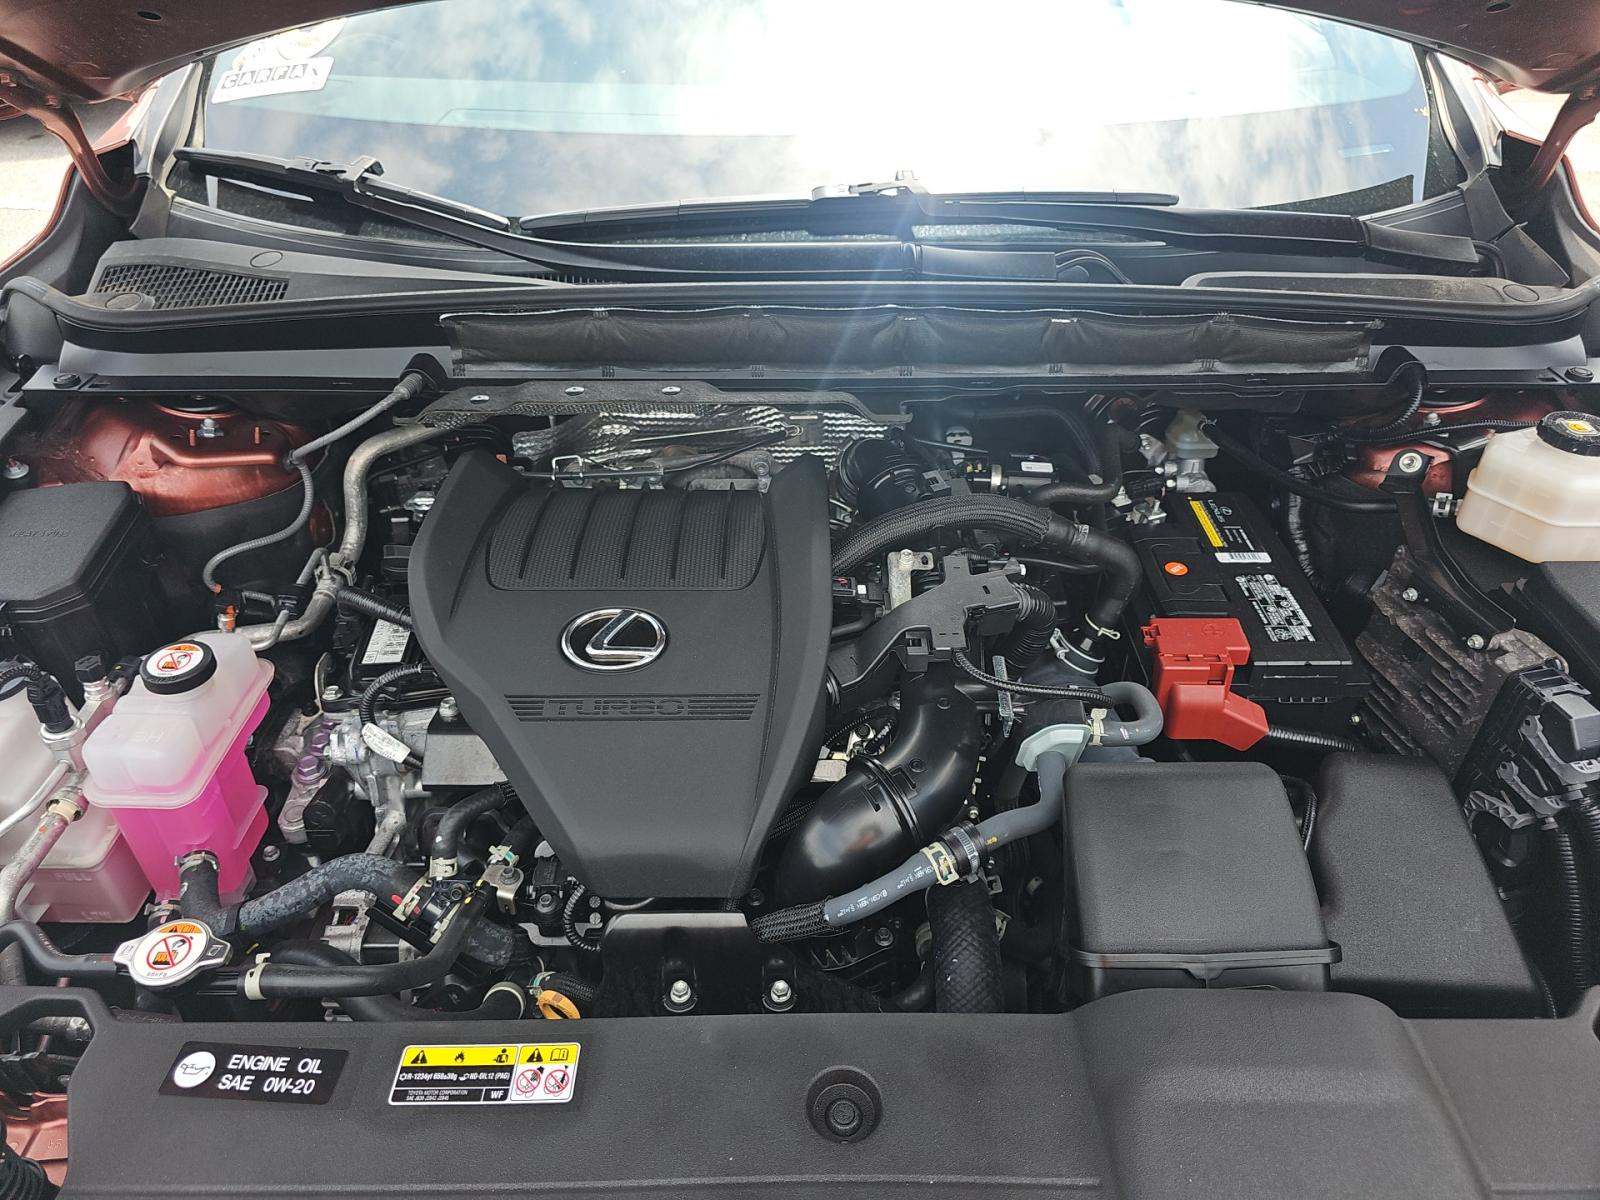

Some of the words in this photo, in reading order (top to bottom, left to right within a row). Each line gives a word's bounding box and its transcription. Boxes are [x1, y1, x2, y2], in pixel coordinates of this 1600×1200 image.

[549, 699, 685, 715] TURBO
[227, 1054, 290, 1072] ENGINE
[297, 1057, 322, 1074] OIL
[217, 1073, 255, 1091] SAE
[263, 1077, 316, 1095] 0W-20
[490, 1090, 505, 1100] WF
